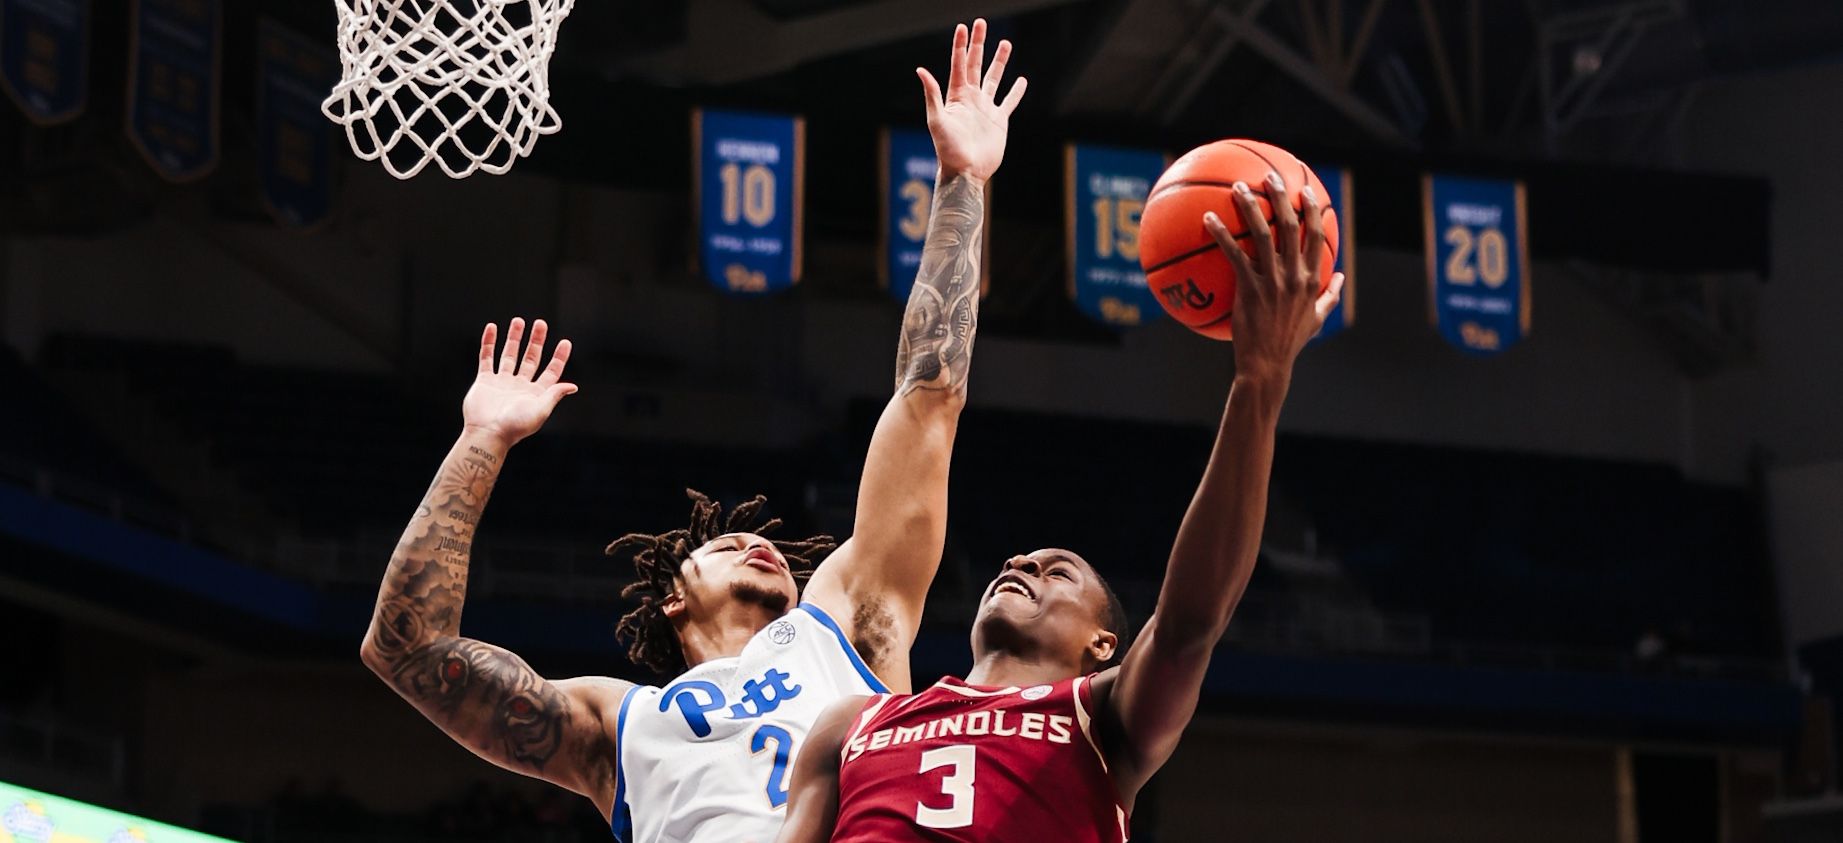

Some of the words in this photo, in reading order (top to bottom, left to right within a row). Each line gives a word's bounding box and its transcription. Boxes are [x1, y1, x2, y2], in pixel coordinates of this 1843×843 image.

[721, 164, 776, 227] 10
[900, 179, 934, 242] 3
[1094, 197, 1142, 261] 15
[1444, 226, 1508, 288] 20
[659, 668, 802, 738] Pitt
[848, 709, 1073, 762] SEMINOLES
[750, 724, 793, 811] 2
[916, 744, 976, 829] 3
